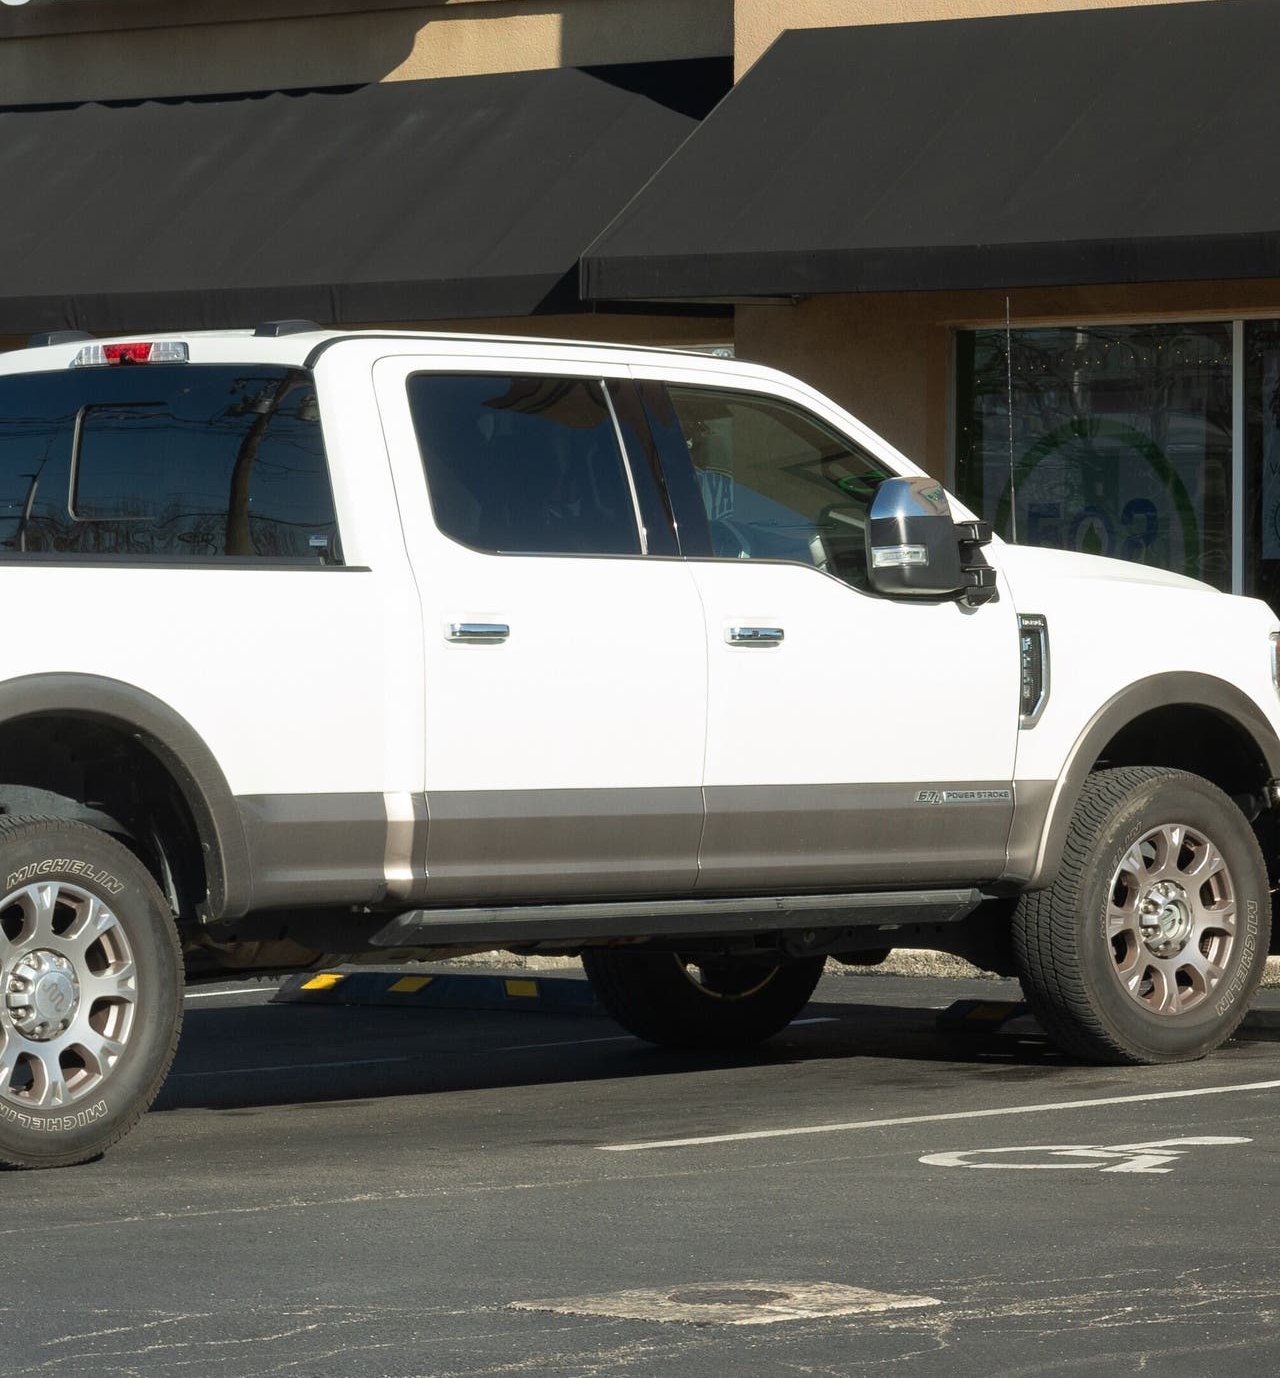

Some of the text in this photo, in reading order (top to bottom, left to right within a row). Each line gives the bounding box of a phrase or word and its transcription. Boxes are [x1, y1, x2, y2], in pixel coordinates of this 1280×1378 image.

[947, 791, 975, 799] POWER
[977, 791, 1009, 799] STROKE
[6, 857, 125, 895] MICHELIN
[1215, 899, 1258, 1017] MICHELIN
